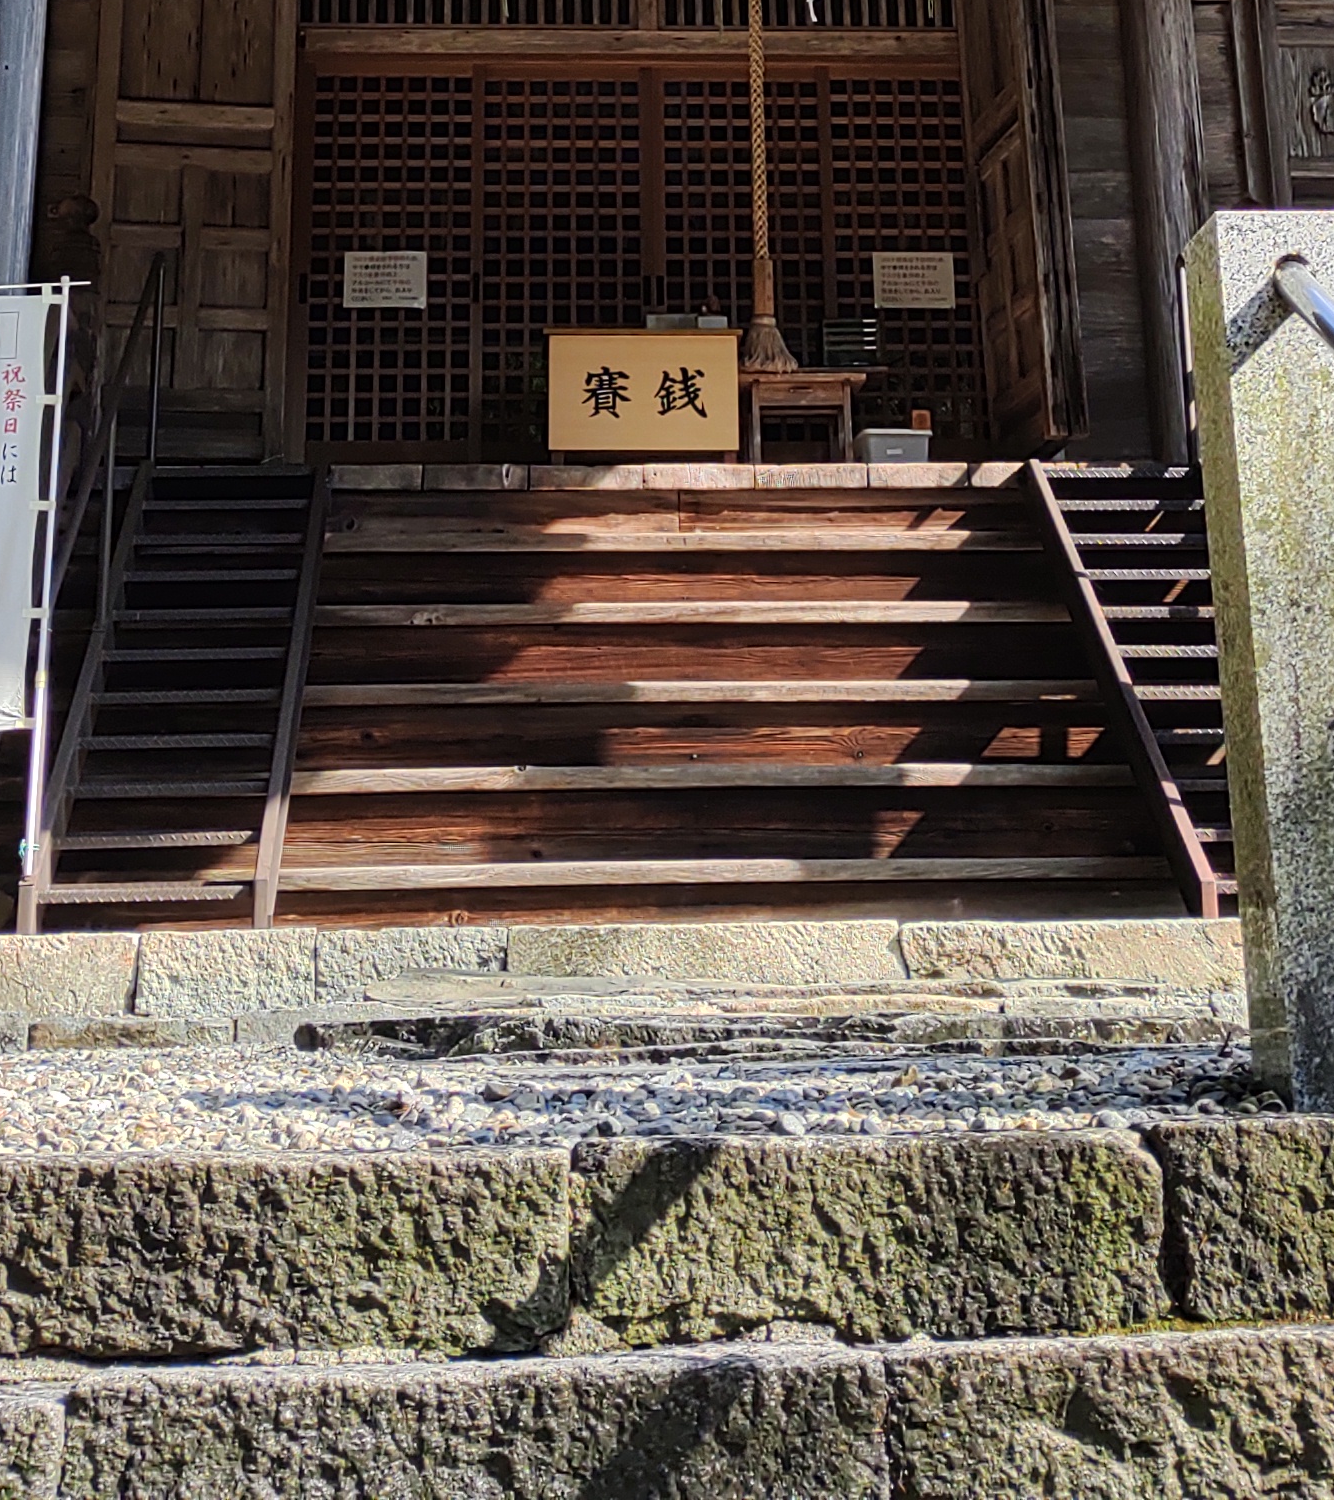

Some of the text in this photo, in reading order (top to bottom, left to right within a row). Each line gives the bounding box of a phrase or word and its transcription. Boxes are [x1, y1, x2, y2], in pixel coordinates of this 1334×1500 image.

[0, 363, 28, 485] 祝祭日には
[581, 365, 708, 419] 賽銭
